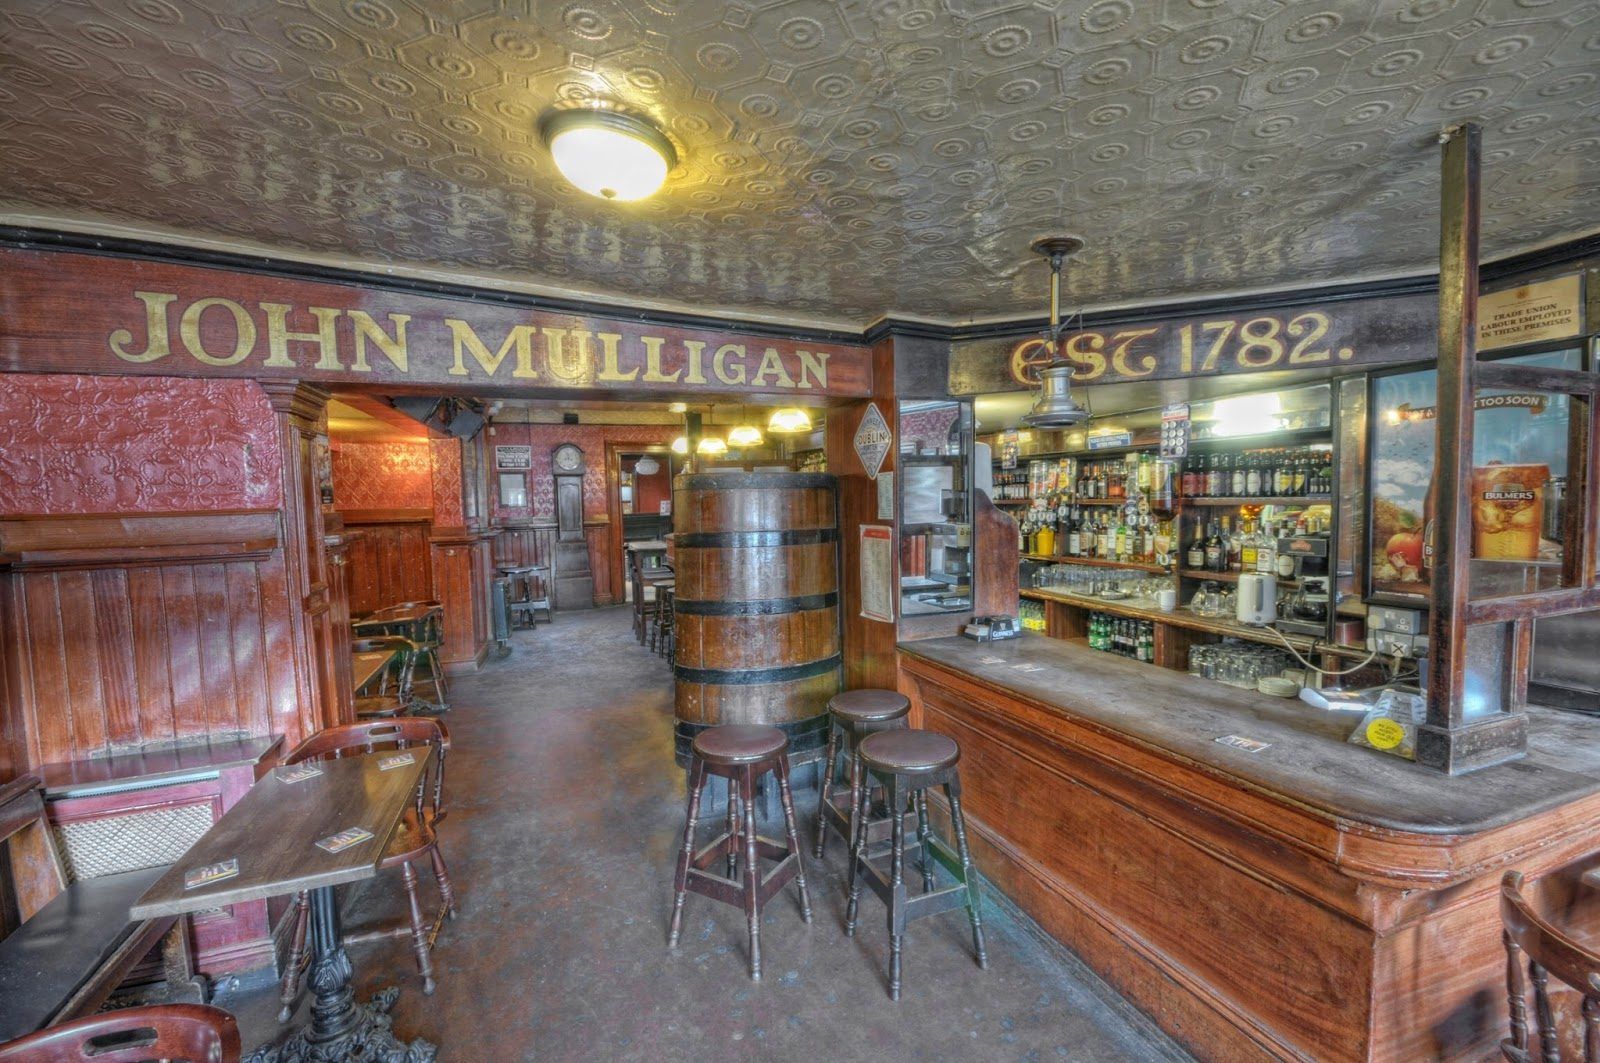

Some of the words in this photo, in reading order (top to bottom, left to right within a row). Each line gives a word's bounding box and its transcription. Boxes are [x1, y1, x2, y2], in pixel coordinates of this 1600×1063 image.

[1480, 319, 1517, 331] LABOUR
[1519, 308, 1572, 324] EMPLOYED
[1494, 309, 1524, 321] TRADE
[1526, 302, 1558, 313] UNION
[1481, 331, 1491, 339] IN
[1494, 325, 1522, 337] THESE
[1524, 316, 1572, 331] PREMISES
[109, 290, 411, 373] JOHN
[444, 318, 830, 389] MULLIGAN
[1179, 312, 1354, 373] 1782.
[1480, 396, 1505, 407] TOO
[1505, 395, 1540, 406] SOON
[858, 431, 887, 446] DUBLIN
[1485, 491, 1534, 500] BULMERS
[992, 630, 1013, 638] GUINNESS
